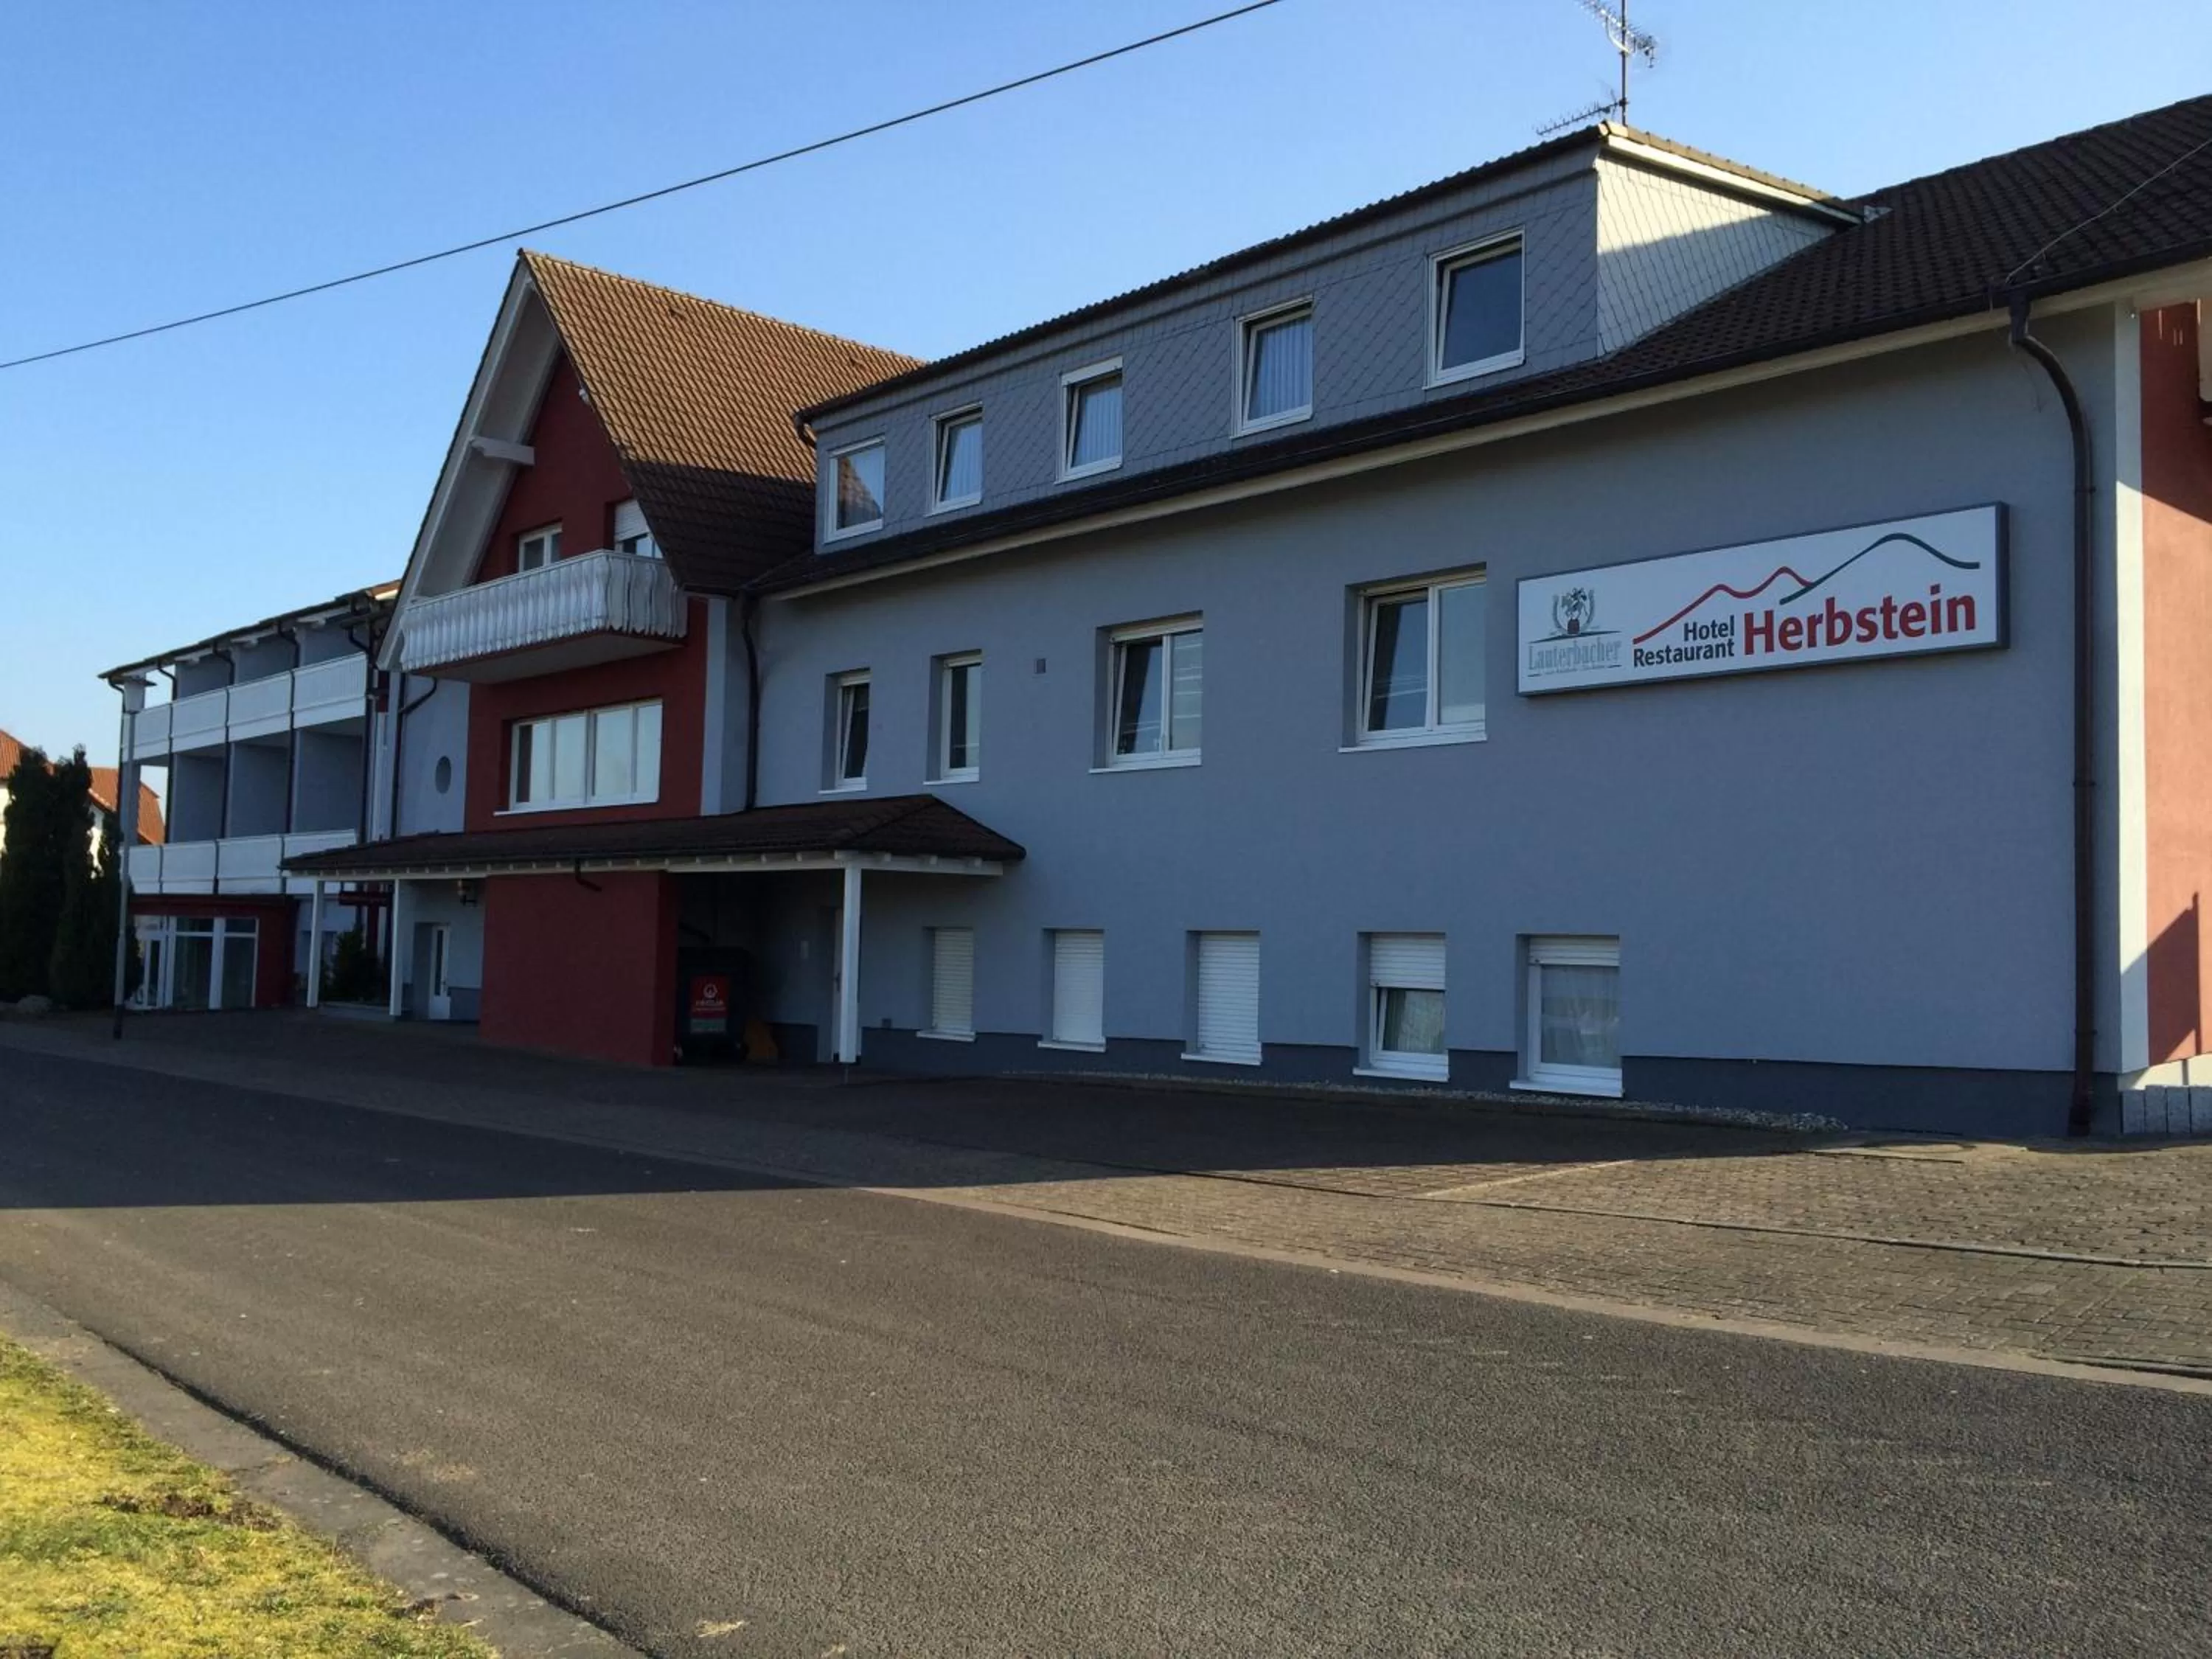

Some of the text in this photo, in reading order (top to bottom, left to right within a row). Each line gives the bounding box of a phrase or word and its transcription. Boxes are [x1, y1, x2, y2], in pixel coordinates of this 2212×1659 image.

[1683, 615, 1735, 642] Hotel
[1744, 583, 1976, 655] Herbstein
[1528, 637, 1622, 670] Lauterbacher
[1633, 639, 1735, 668] Restaurant
